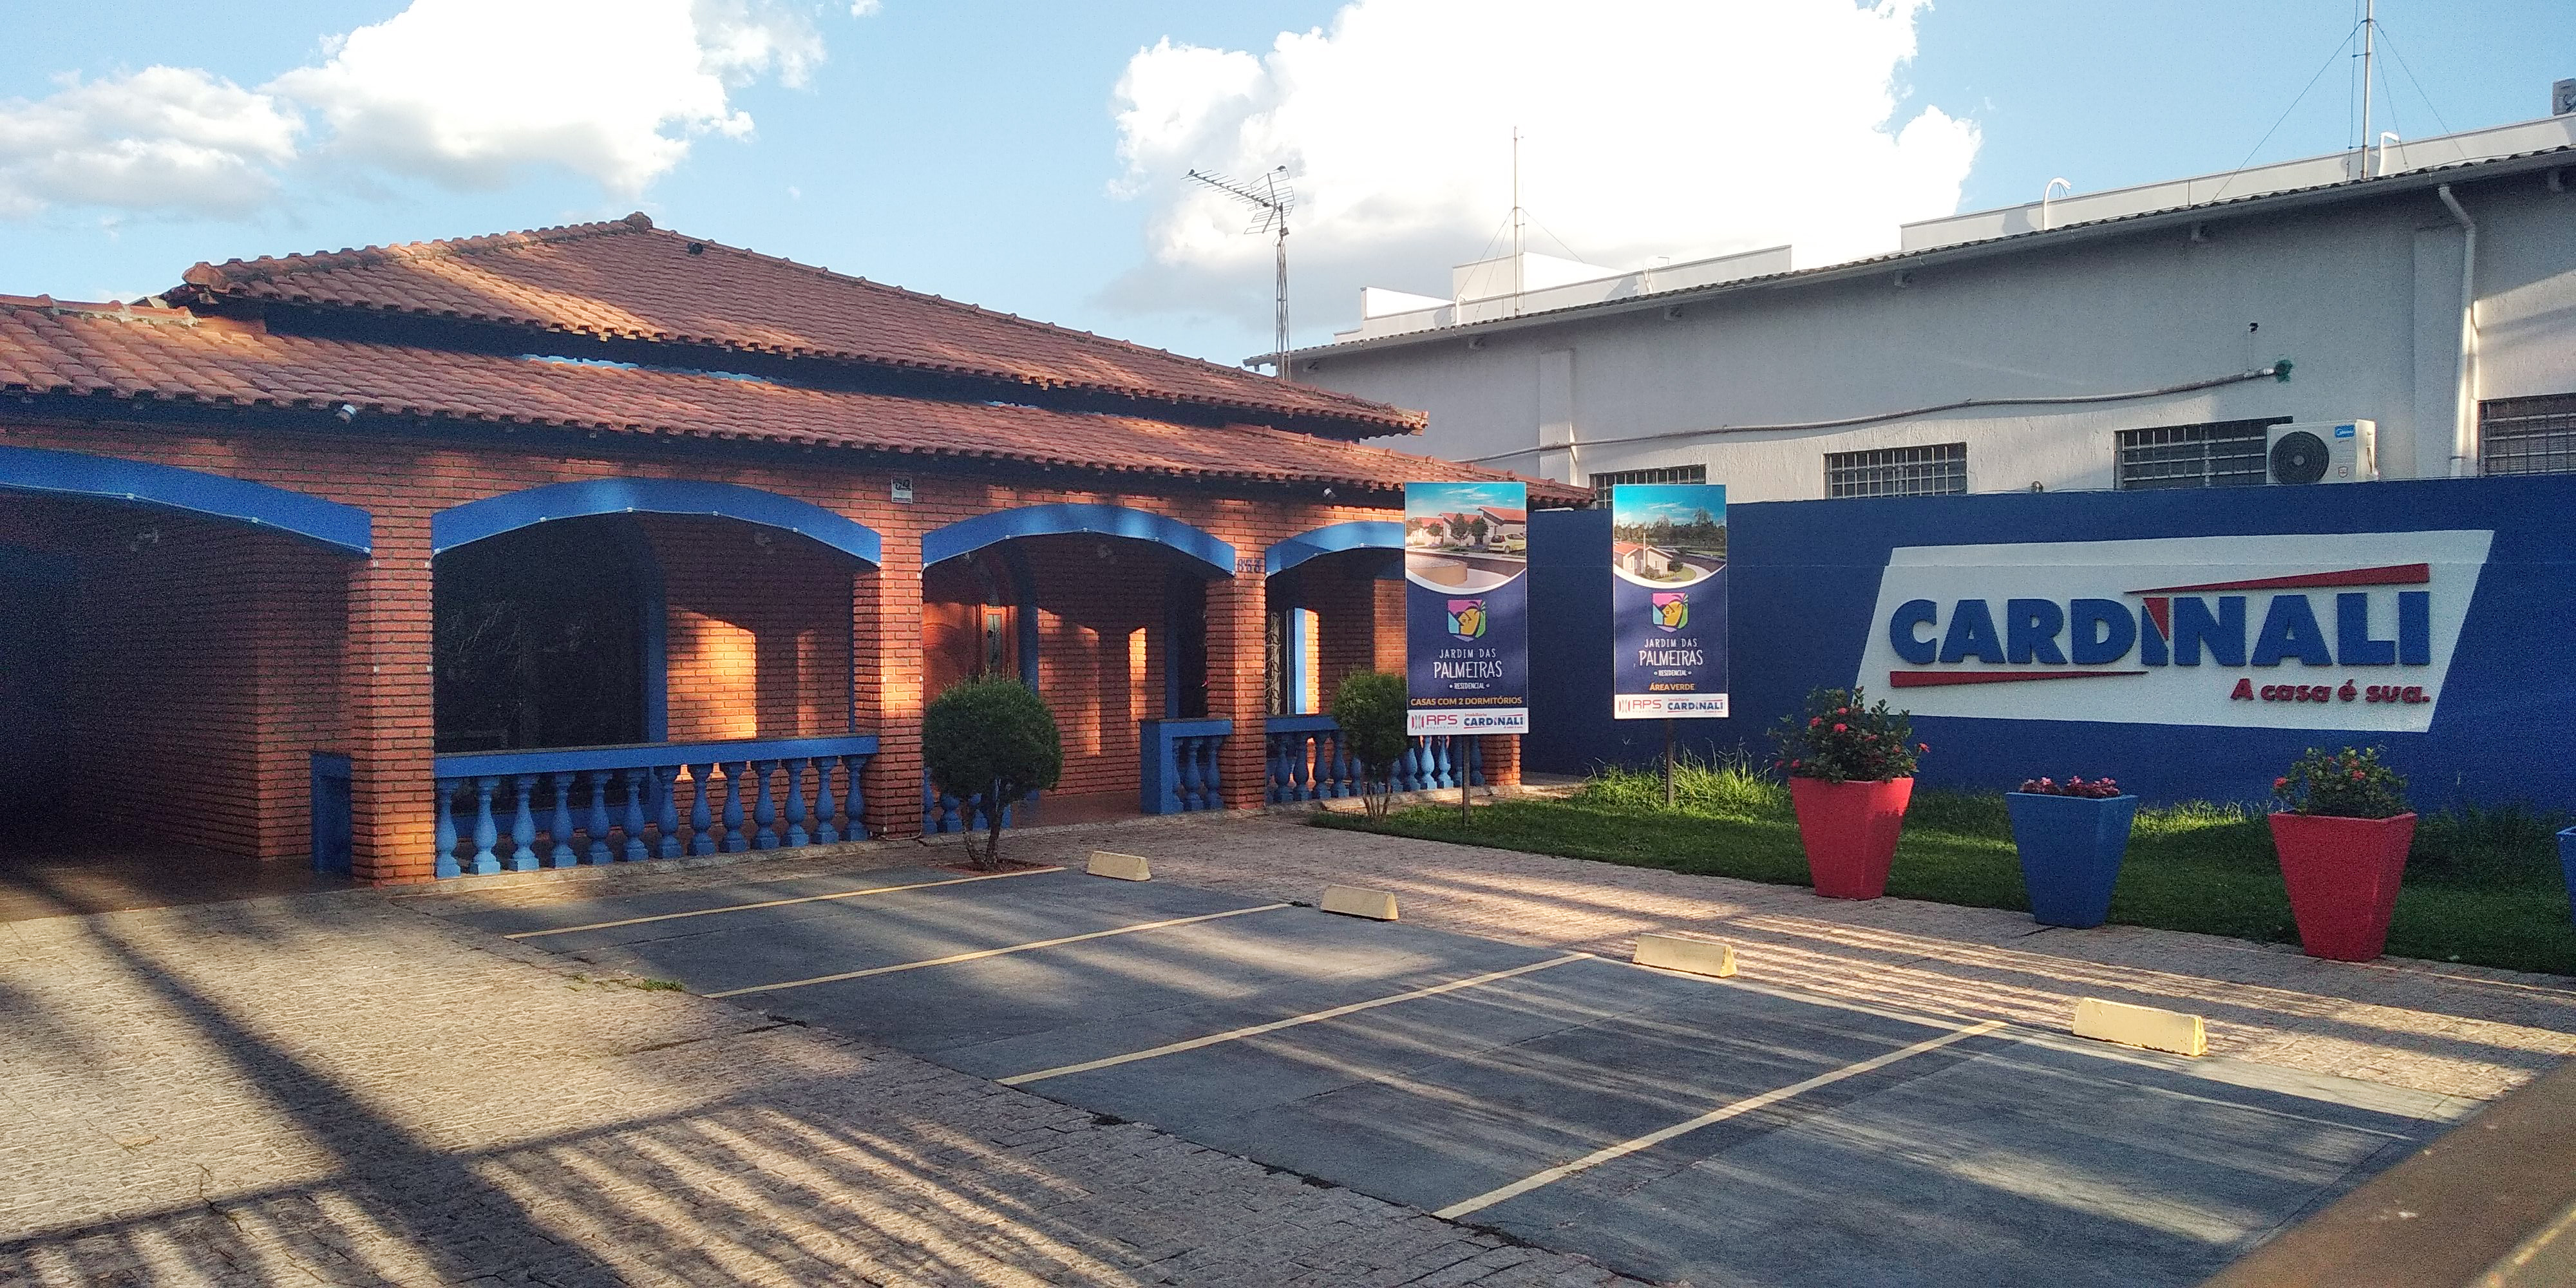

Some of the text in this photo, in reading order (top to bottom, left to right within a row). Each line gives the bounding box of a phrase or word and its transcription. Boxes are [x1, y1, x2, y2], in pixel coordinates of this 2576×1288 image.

[1889, 591, 2430, 667] CARDINALI
[1644, 638, 1698, 648] JARDIM DAS
[1439, 648, 1496, 659] JARDIM DAS
[1638, 649, 1703, 667] PALMEIRAS
[1433, 660, 1502, 679] PALMEIRAS
[1649, 682, 1670, 691] ÁREA
[2230, 678, 2430, 703] A casa é sua.
[1465, 696, 1522, 705] DORMITÓRIOS
[1633, 699, 1662, 709] RPS
[1667, 702, 1723, 710] CARDINALI
[1426, 714, 1458, 725] RPS
[1463, 717, 1524, 726] CARDINALI
